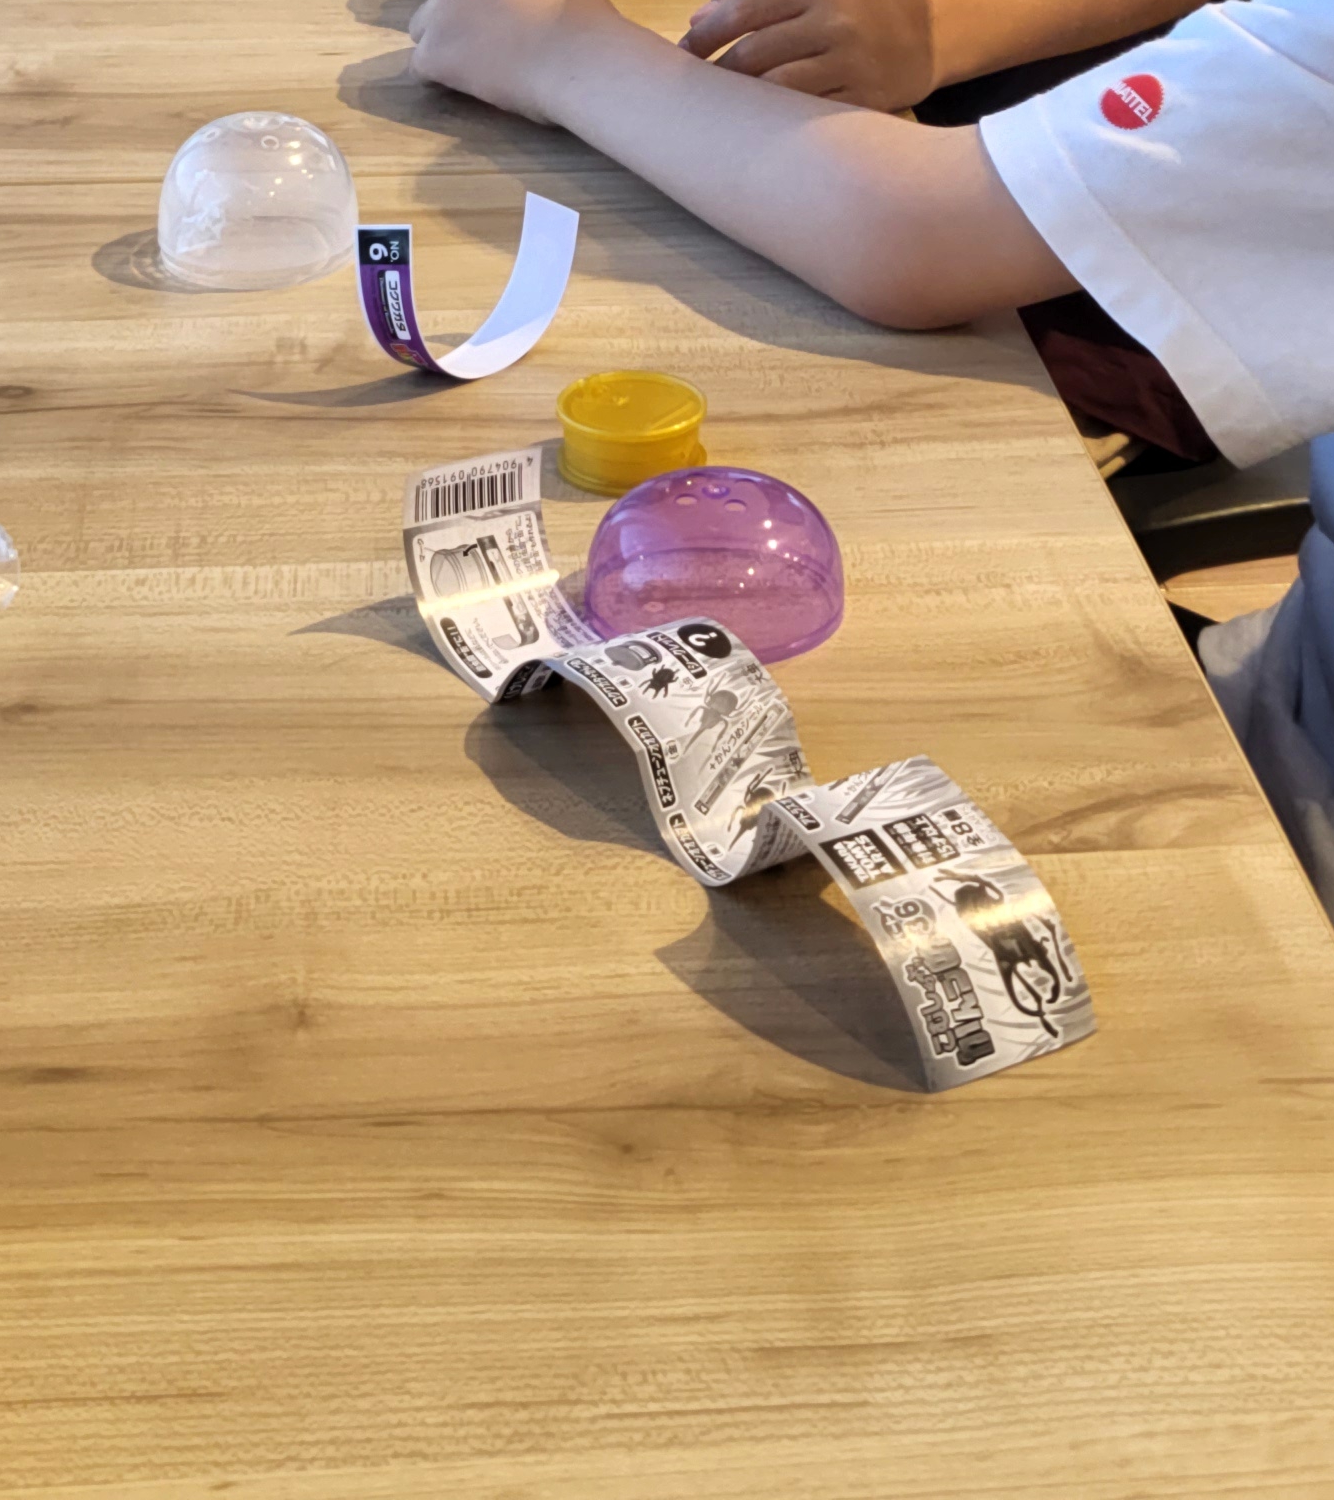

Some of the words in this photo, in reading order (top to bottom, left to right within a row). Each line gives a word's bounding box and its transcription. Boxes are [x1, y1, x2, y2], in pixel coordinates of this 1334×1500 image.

[1111, 80, 1153, 125] MATTEL
[369, 242, 389, 261] 6
[389, 240, 400, 263] NO.
[387, 279, 407, 333] コクワガタ
[419, 470, 465, 490] 091568
[471, 458, 517, 478] 904790
[631, 718, 673, 807] ネプチューンオオカブト
[843, 837, 881, 879] TOMY
[892, 819, 935, 865] 対象年齢
[915, 814, 956, 859] 15才以上
[832, 840, 868, 883] TAKARA
[892, 897, 930, 936] 36
[920, 937, 996, 1067] かんづめ
